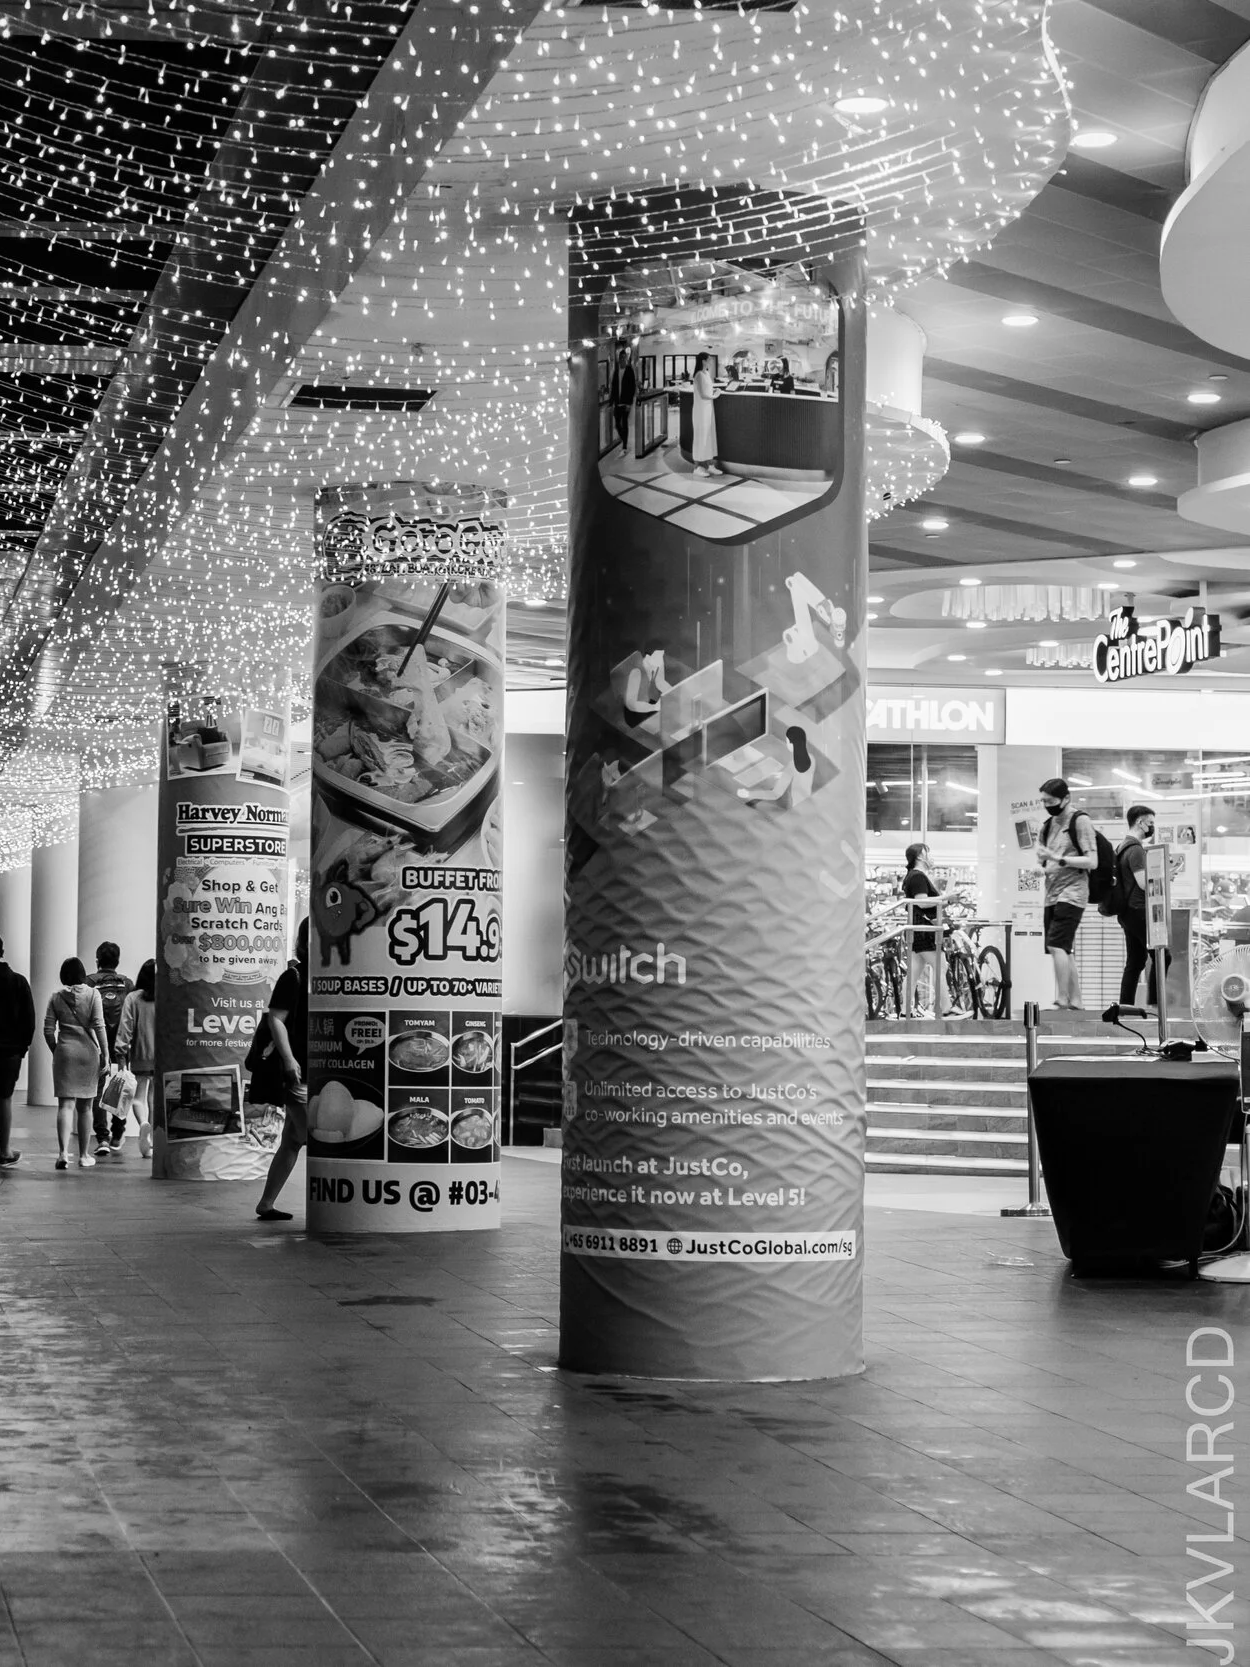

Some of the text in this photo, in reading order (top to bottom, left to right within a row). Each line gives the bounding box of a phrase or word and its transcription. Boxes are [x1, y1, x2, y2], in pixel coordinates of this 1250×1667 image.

[1109, 606, 1130, 640] The
[866, 698, 994, 731] ATHLON
[178, 804, 289, 824] Harvey Norma
[190, 837, 286, 854] SUPERSTORE
[210, 858, 246, 866] Computers
[202, 879, 279, 894] Shop & Get
[404, 868, 501, 890] BUFFET FRO
[172, 897, 212, 913] Sure
[214, 896, 252, 914] Win
[255, 902, 278, 917] Ang
[191, 917, 283, 931] Scratch Cards
[391, 900, 501, 962] $14.9
[198, 932, 282, 953] $800,000
[199, 955, 210, 963] to
[213, 955, 226, 963] be
[228, 955, 256, 965] given
[317, 980, 341, 992] SOUP
[344, 980, 385, 992] BASES
[406, 981, 427, 993] UP
[430, 981, 450, 993] TO
[453, 982, 473, 994] 70+
[475, 982, 502, 994] VARIET
[211, 997, 265, 1009] Visit us at
[186, 1037, 199, 1047] for
[200, 1039, 223, 1047] more
[351, 1028, 382, 1038] FREE!
[586, 1030, 831, 1052] Technology-driven capabilities
[327, 1059, 375, 1069] COLLAGEN
[584, 1081, 817, 1100] Unlimited access to JustCo's
[585, 1107, 844, 1128] co-working amenities and events
[582, 1154, 633, 1173] launch
[637, 1158, 658, 1174] at
[663, 1157, 749, 1179] JustCo,
[309, 1176, 354, 1203] FIND
[362, 1180, 400, 1205] US
[409, 1181, 440, 1212] @
[631, 1185, 646, 1203] it
[650, 1190, 695, 1205] now
[699, 1188, 723, 1205] at
[728, 1187, 784, 1206] Level
[788, 1188, 806, 1206] 5!
[586, 1235, 616, 1251] 6911
[619, 1237, 658, 1253] 8891
[686, 1238, 853, 1256] JustCoGlobal.com/sg
